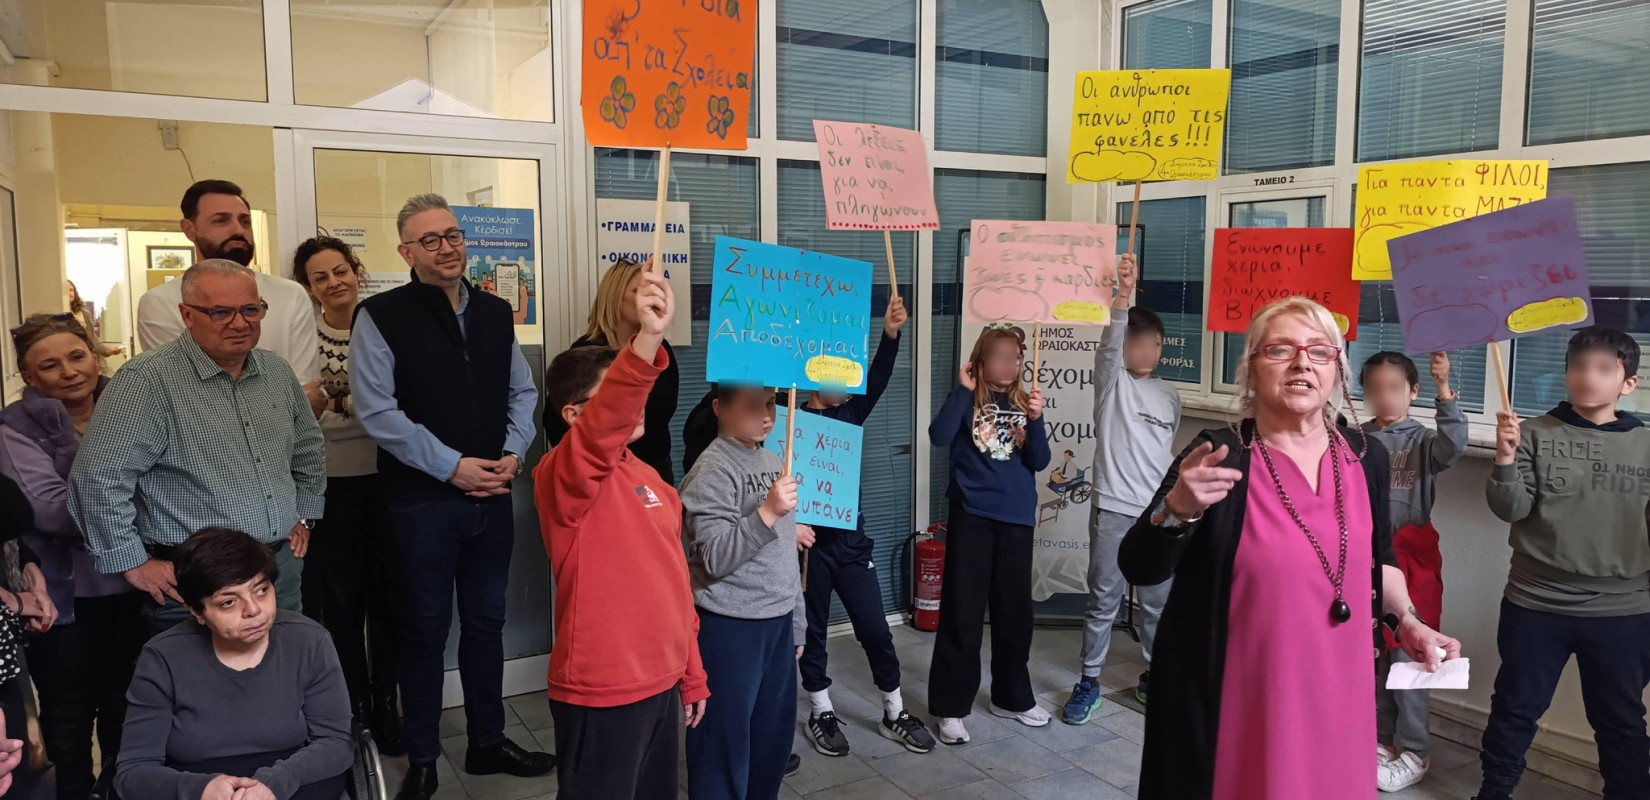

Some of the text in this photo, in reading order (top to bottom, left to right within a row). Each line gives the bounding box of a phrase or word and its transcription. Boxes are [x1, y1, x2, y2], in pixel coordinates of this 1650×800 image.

[1082, 77, 1098, 98] Οι
[1143, 101, 1176, 124] από
[1189, 109, 1223, 123] τις
[824, 125, 842, 146] Οι
[827, 150, 851, 167] δεν
[1254, 175, 1295, 186] ΤΑΜΕΙΟ 2
[1366, 169, 1388, 190] Για
[1475, 163, 1544, 189] ΦΙΛΟΙ,
[832, 177, 893, 195] για να
[461, 214, 523, 225] Ανακύκλωσε.
[1360, 205, 1387, 228] για
[475, 225, 513, 236] Κέρδισε!
[607, 221, 685, 233] ΓΡΑΜΜΑΕΙΑ
[978, 224, 989, 243] Ο
[480, 239, 528, 247] Ωραιοκάστρου
[1160, 357, 1195, 368] ΦΟΡΑΣ
[1043, 397, 1057, 409] αι
[778, 440, 799, 461] δν
[1537, 439, 1602, 461] FREE
[1592, 462, 1609, 473] TO
[816, 479, 833, 496] να
[1546, 463, 1571, 494] 5
[1591, 473, 1650, 496] RIDE
[796, 498, 853, 523] υπάνε
[1033, 538, 1090, 551] etavasis.e
